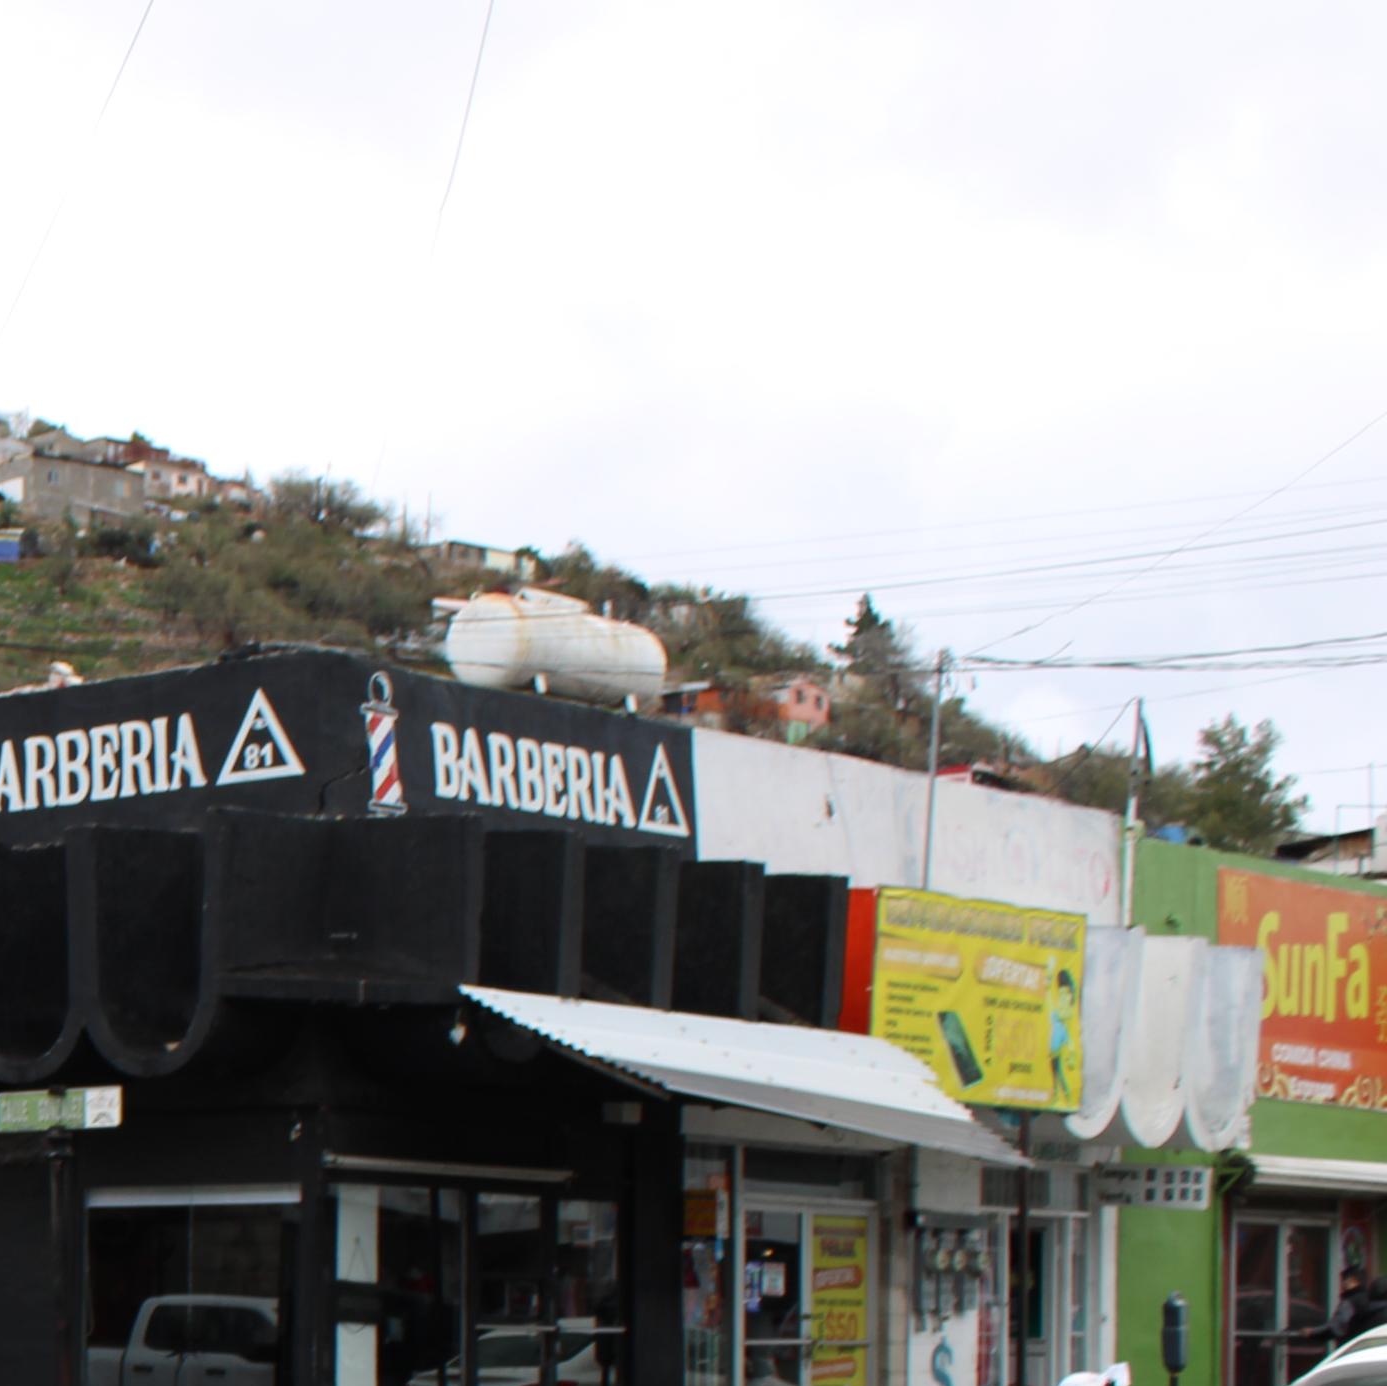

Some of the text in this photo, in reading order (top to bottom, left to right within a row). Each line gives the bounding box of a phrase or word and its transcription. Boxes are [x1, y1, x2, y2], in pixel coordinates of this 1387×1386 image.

[243, 742, 274, 769] 81
[430, 721, 637, 829] BARBERIA
[1257, 911, 1370, 1023] SunFa
